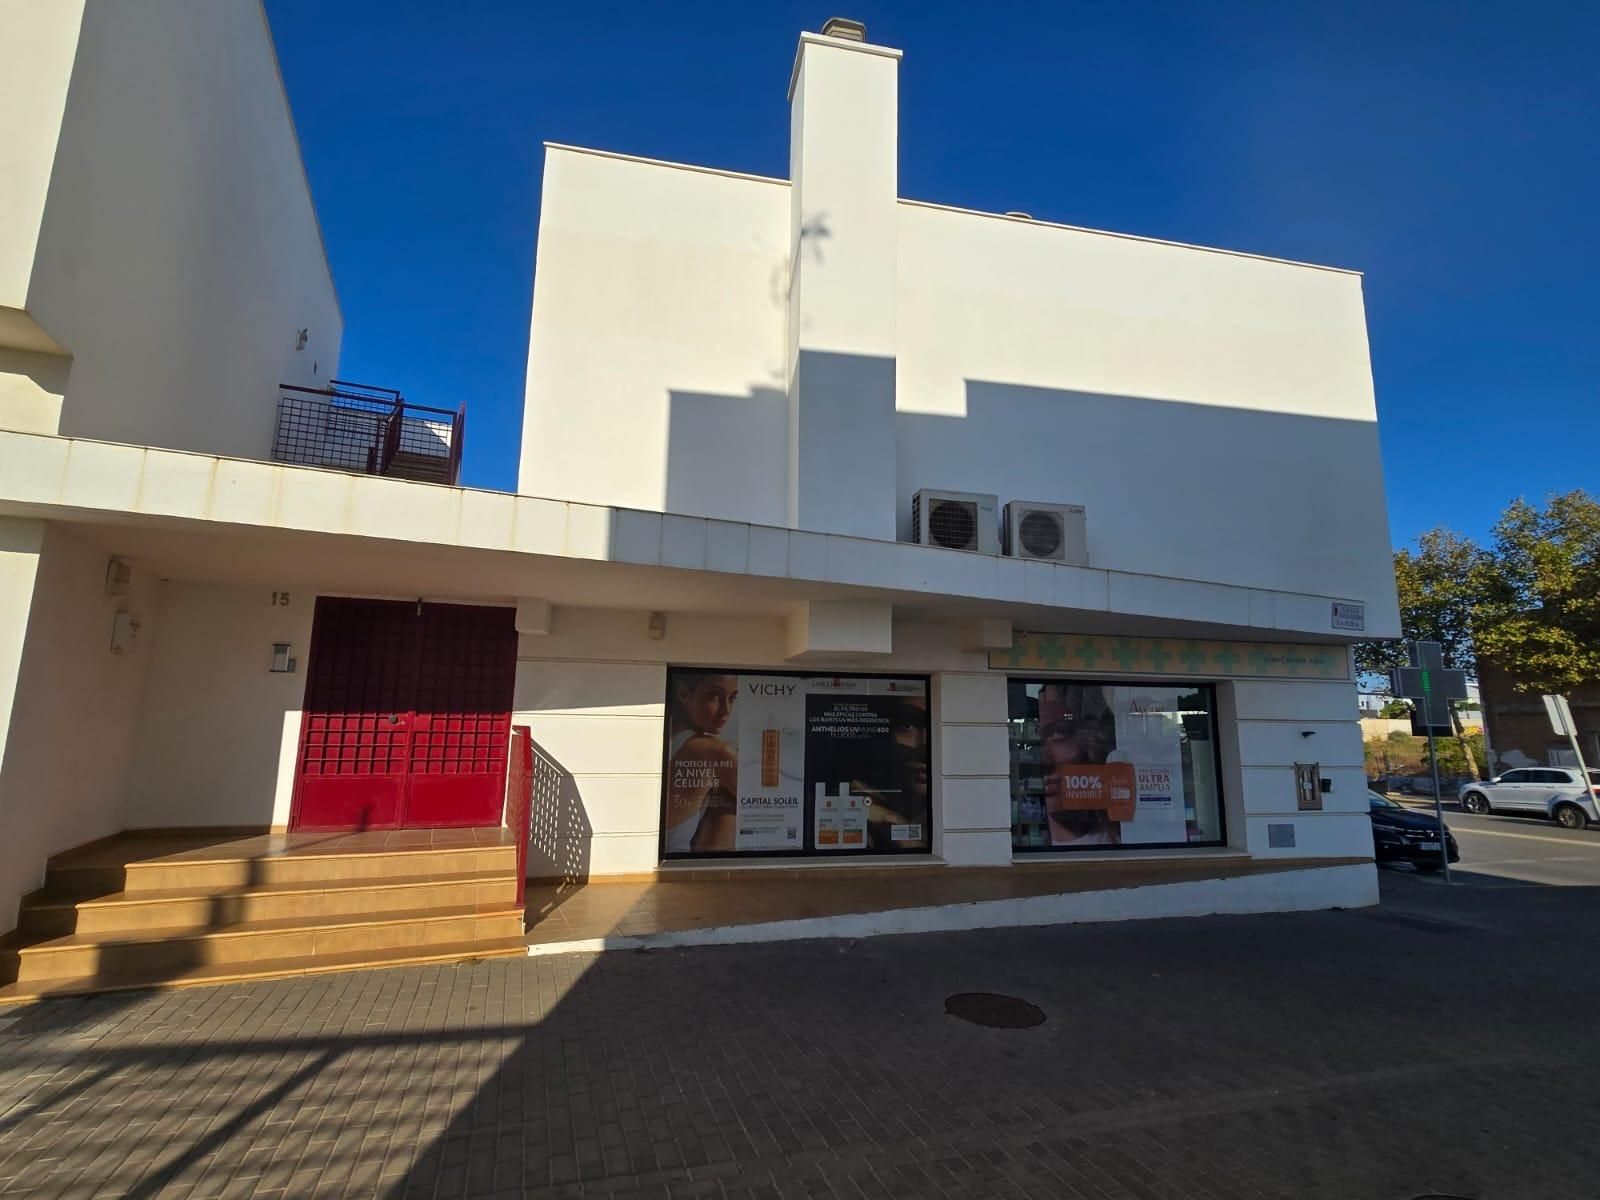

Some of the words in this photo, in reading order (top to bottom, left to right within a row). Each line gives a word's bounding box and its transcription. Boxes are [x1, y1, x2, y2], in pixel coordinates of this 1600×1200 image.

[272, 591, 290, 606] 15
[749, 684, 796, 696] VICHY
[811, 725, 849, 733] ANTHELIOS
[675, 760, 707, 768] PROTEGE
[709, 760, 718, 768] LA
[720, 760, 733, 768] PIEL
[675, 768, 683, 778] A
[686, 768, 716, 778] NIVEL
[1064, 775, 1102, 789] 100%
[1139, 774, 1170, 783] ULTRA
[674, 778, 720, 789] CELULAR
[1065, 790, 1104, 799] INVISIBLE
[741, 797, 772, 805] CAPITAL
[774, 797, 798, 805] SOLEIL
